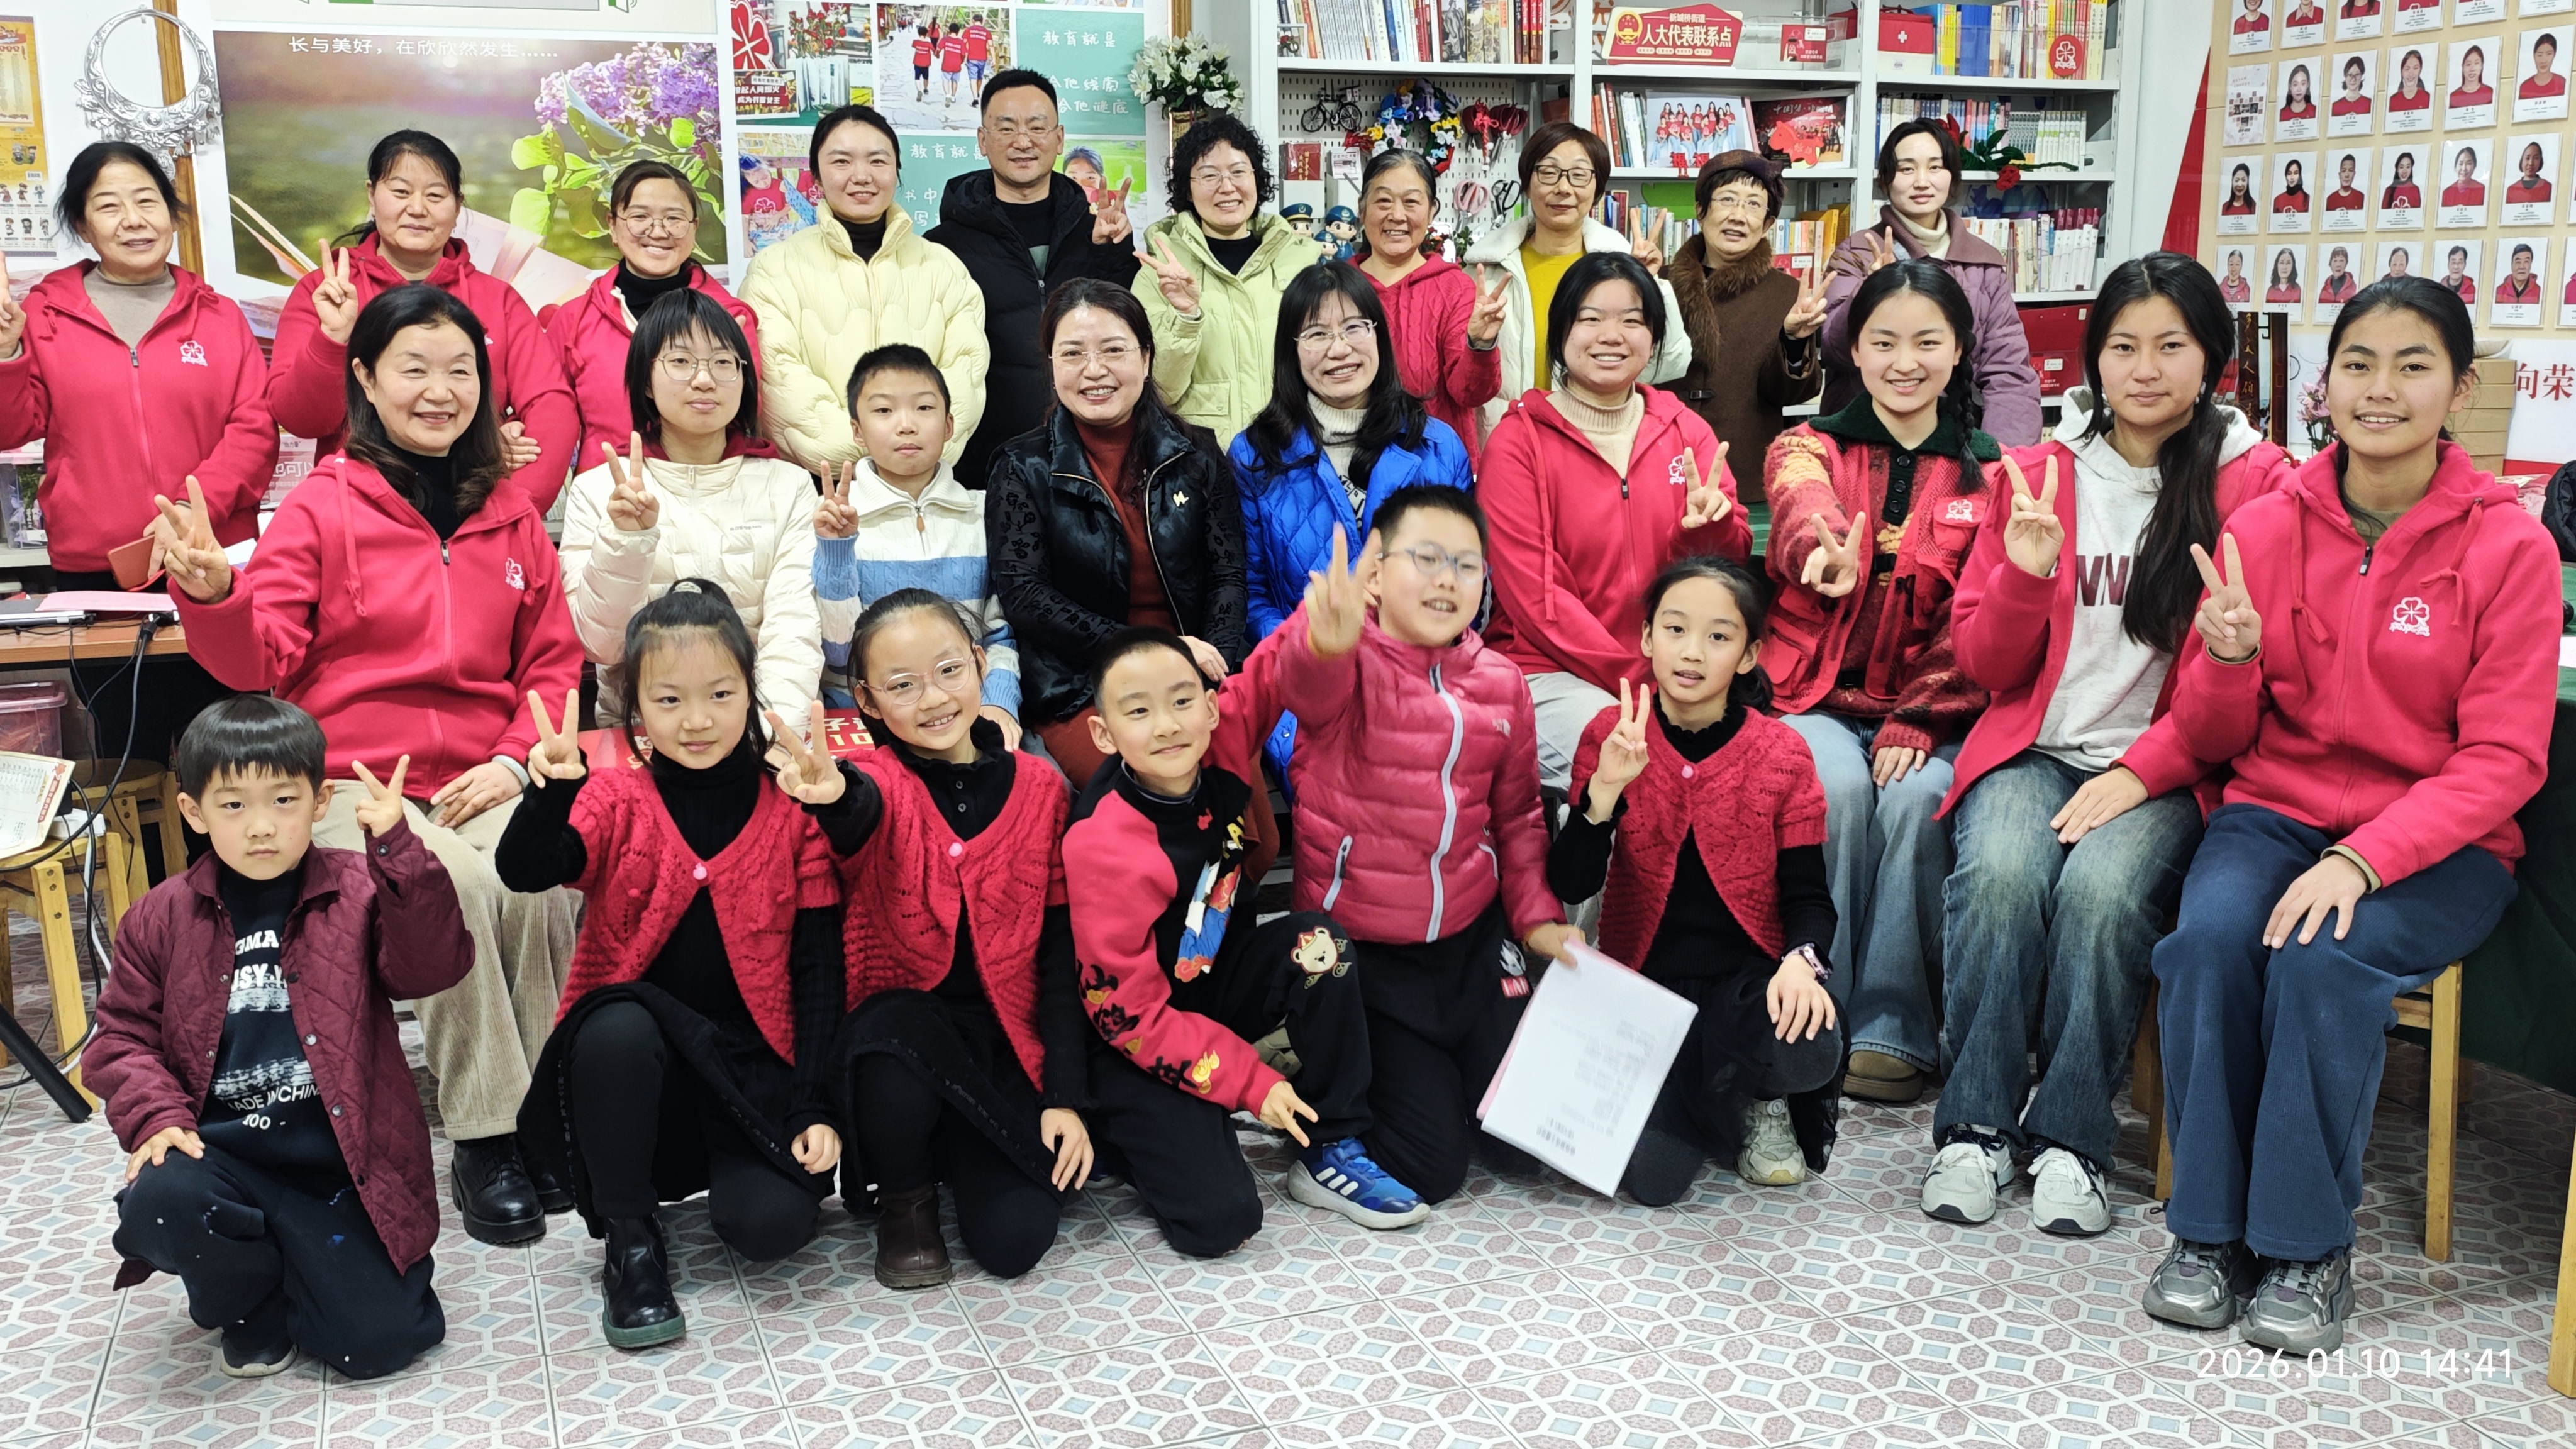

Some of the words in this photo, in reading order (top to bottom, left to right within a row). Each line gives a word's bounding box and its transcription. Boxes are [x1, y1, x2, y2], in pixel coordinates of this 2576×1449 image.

[1669, 13, 1706, 23] 新城桥街道
[1043, 30, 1116, 47] 教育就是
[1642, 23, 1732, 47] 人大代表联系点
[910, 143, 985, 160] 教育就是
[2516, 363, 2575, 401] 向荣
[277, 1084, 320, 1102] CHIN
